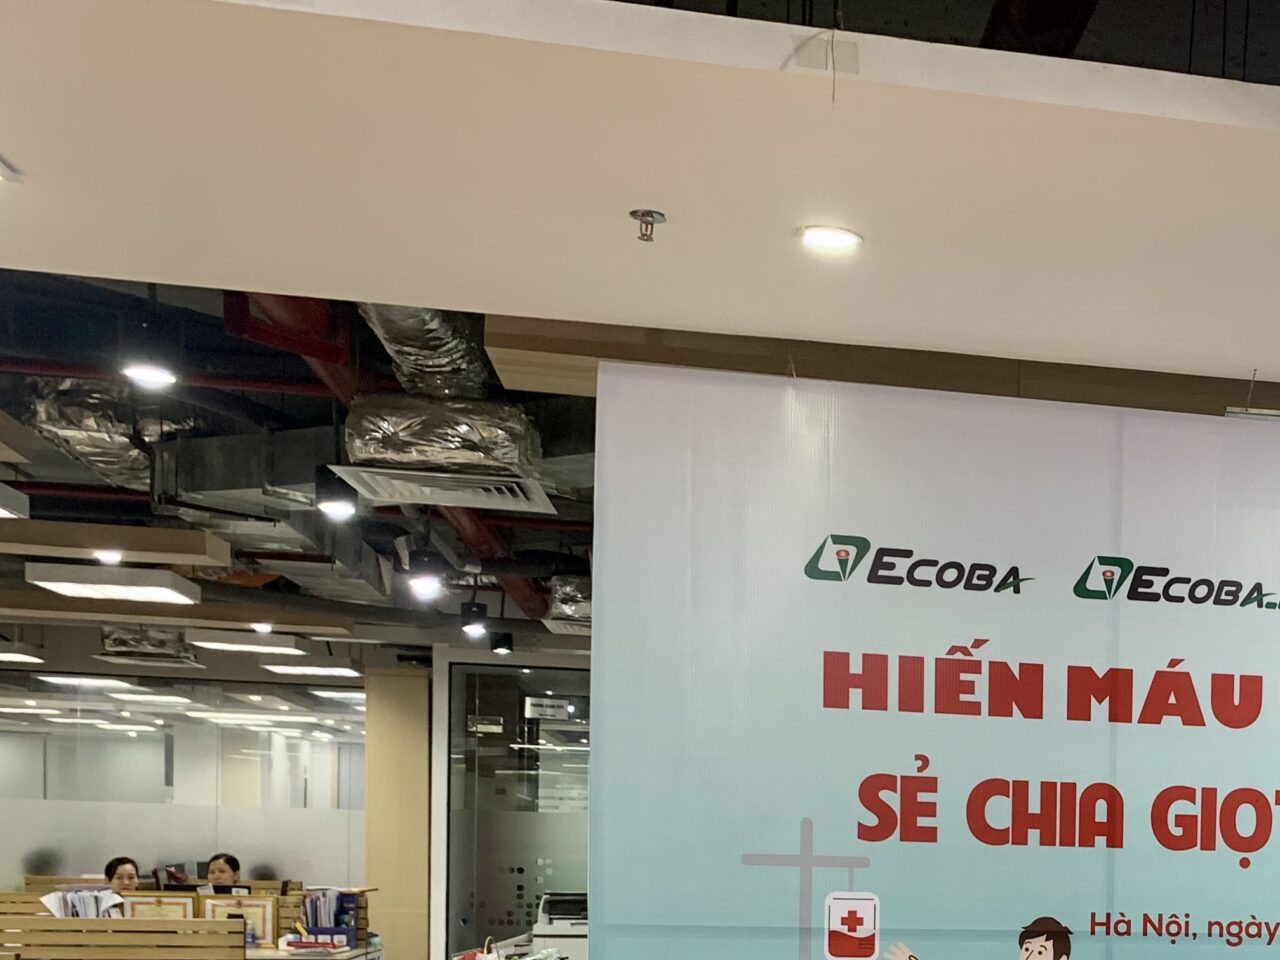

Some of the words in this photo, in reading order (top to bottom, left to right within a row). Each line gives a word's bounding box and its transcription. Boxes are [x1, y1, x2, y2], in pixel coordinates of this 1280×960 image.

[823, 638, 1044, 720] HIẾN
[1066, 658, 1263, 729] MÁU
[857, 753, 938, 843] SẺ
[966, 777, 1124, 849] CHIA
[1089, 912, 1132, 937] Hà
[1142, 913, 1198, 945] Nội,
[1207, 915, 1280, 948] ngày
